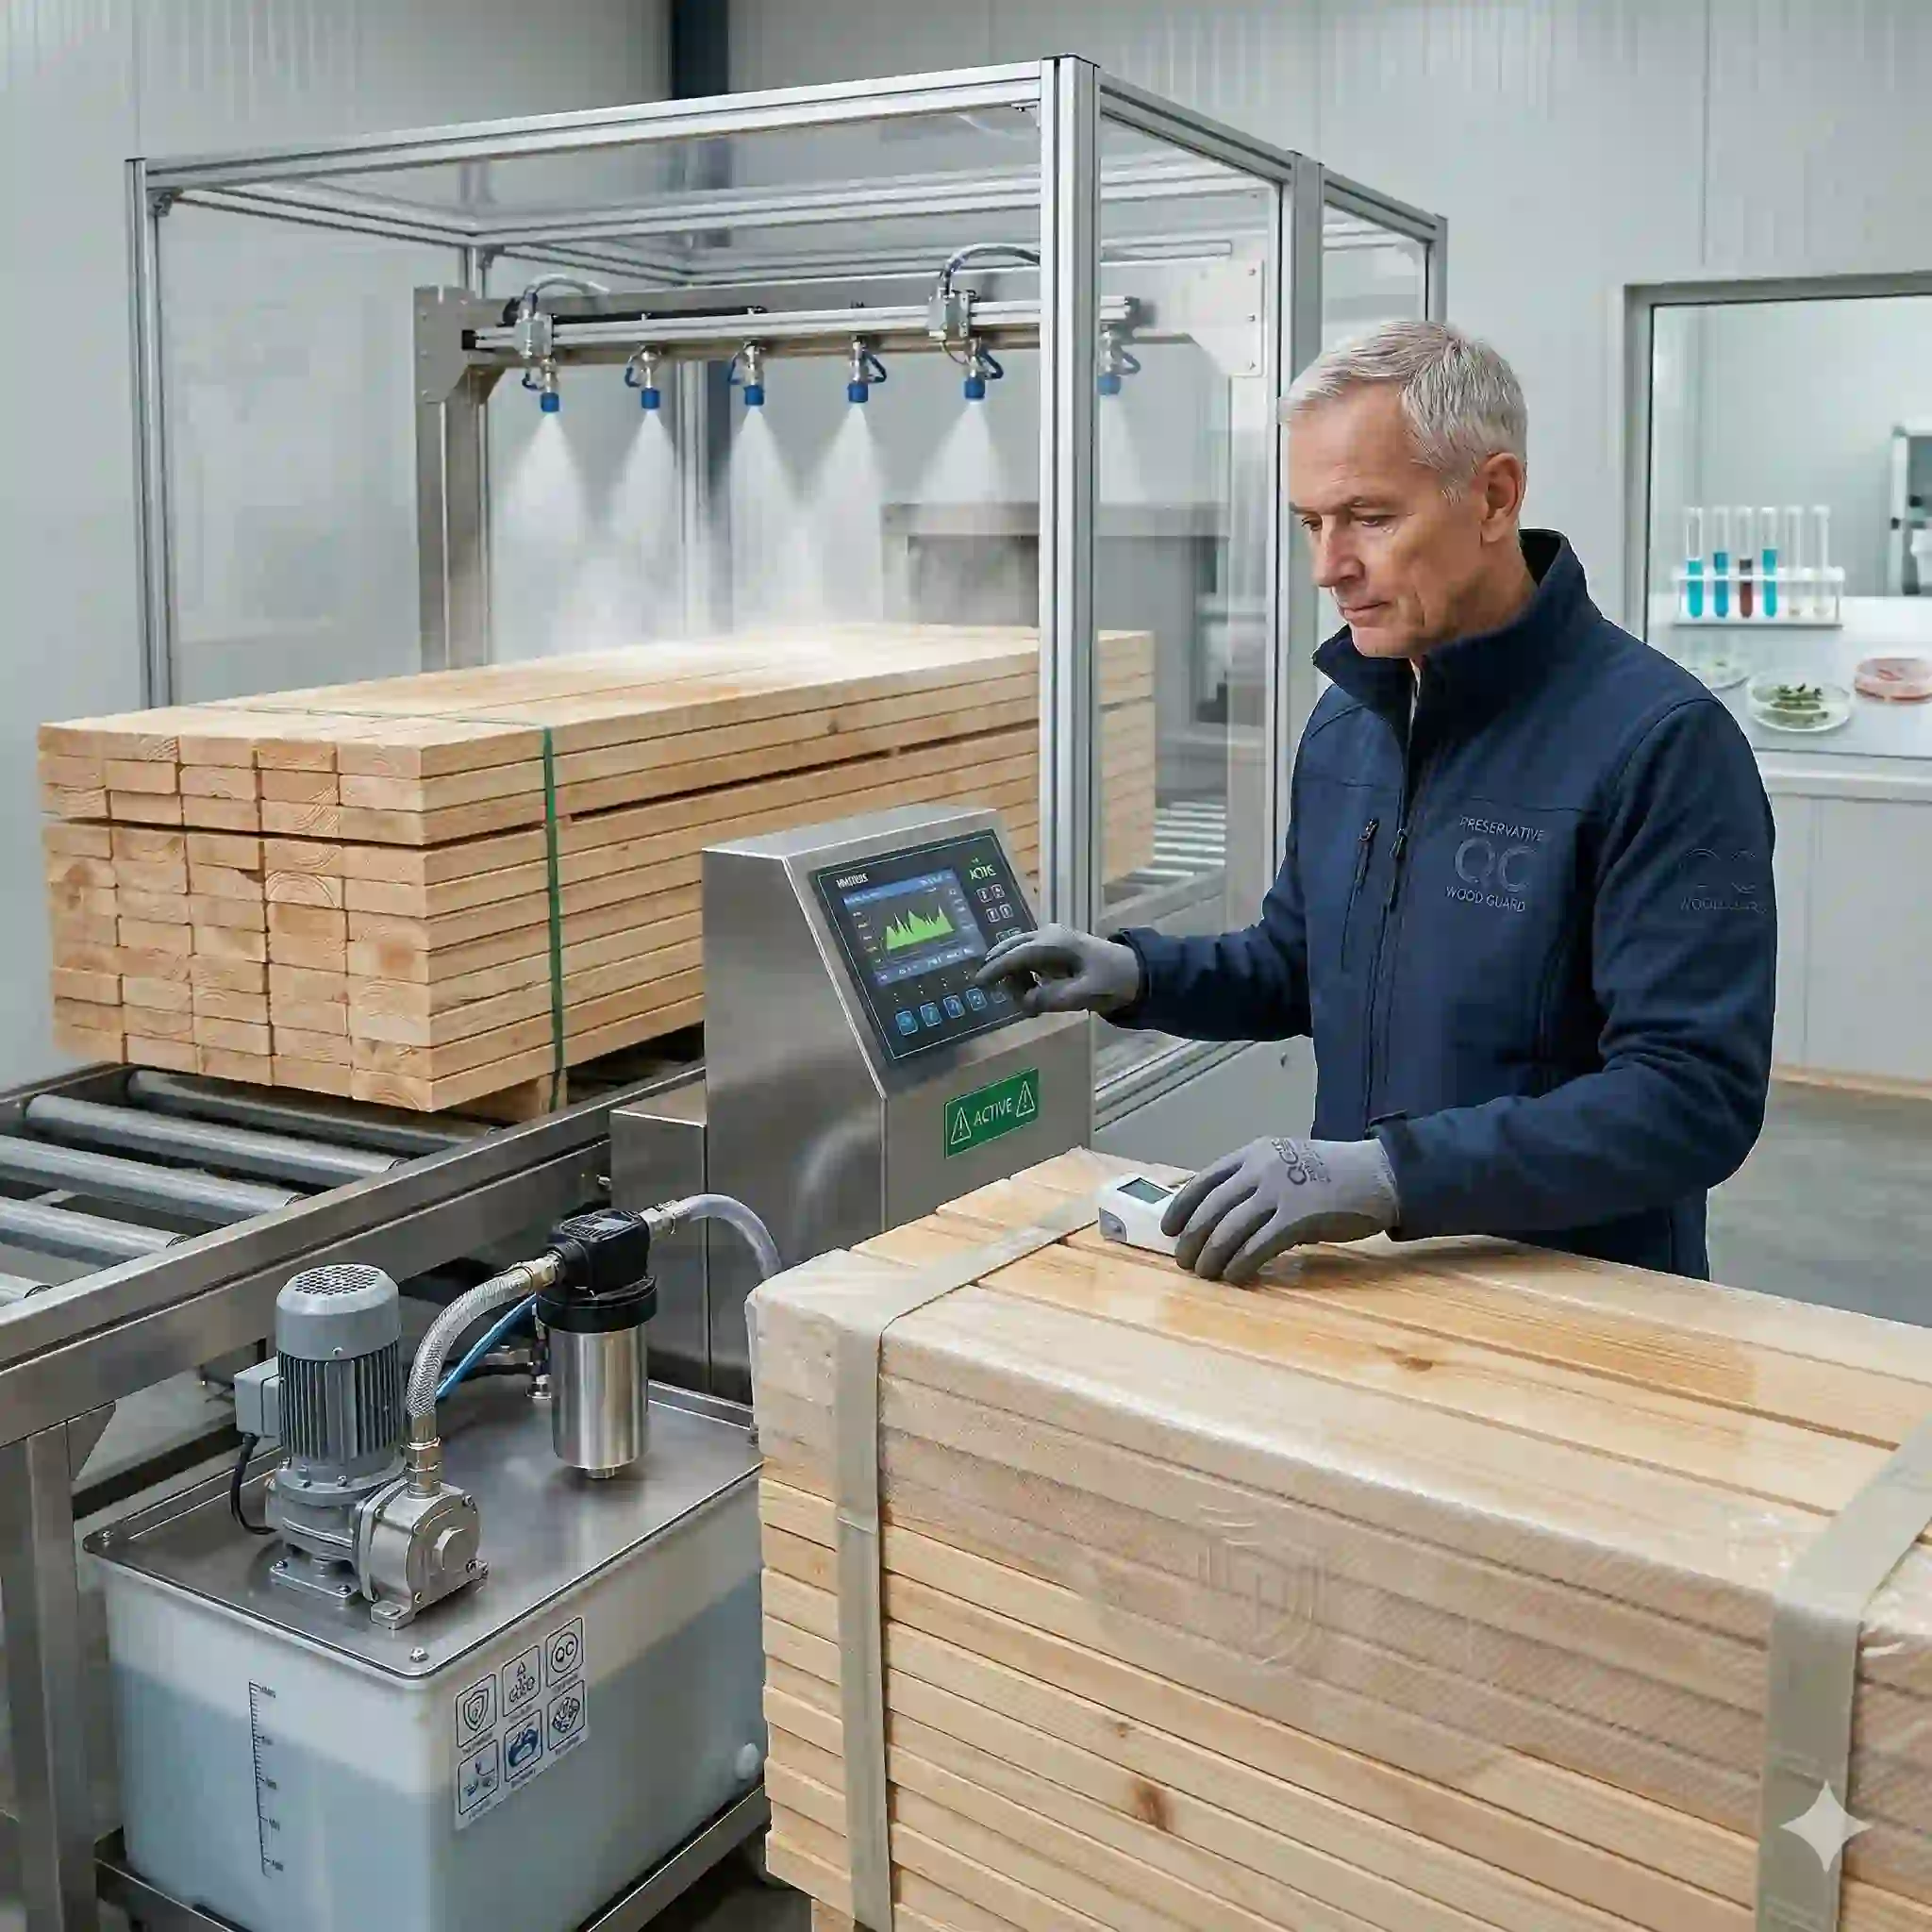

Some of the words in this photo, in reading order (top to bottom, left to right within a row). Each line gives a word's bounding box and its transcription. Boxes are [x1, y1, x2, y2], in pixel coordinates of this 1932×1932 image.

[1459, 815, 1544, 841] PRESERVATIVE
[1455, 837, 1537, 892] QC
[1445, 886, 1484, 904] WOOD
[1486, 893, 1525, 912] GUARD
[974, 1097, 1012, 1126] ACTIVE
[556, 1641, 575, 1663] QC
